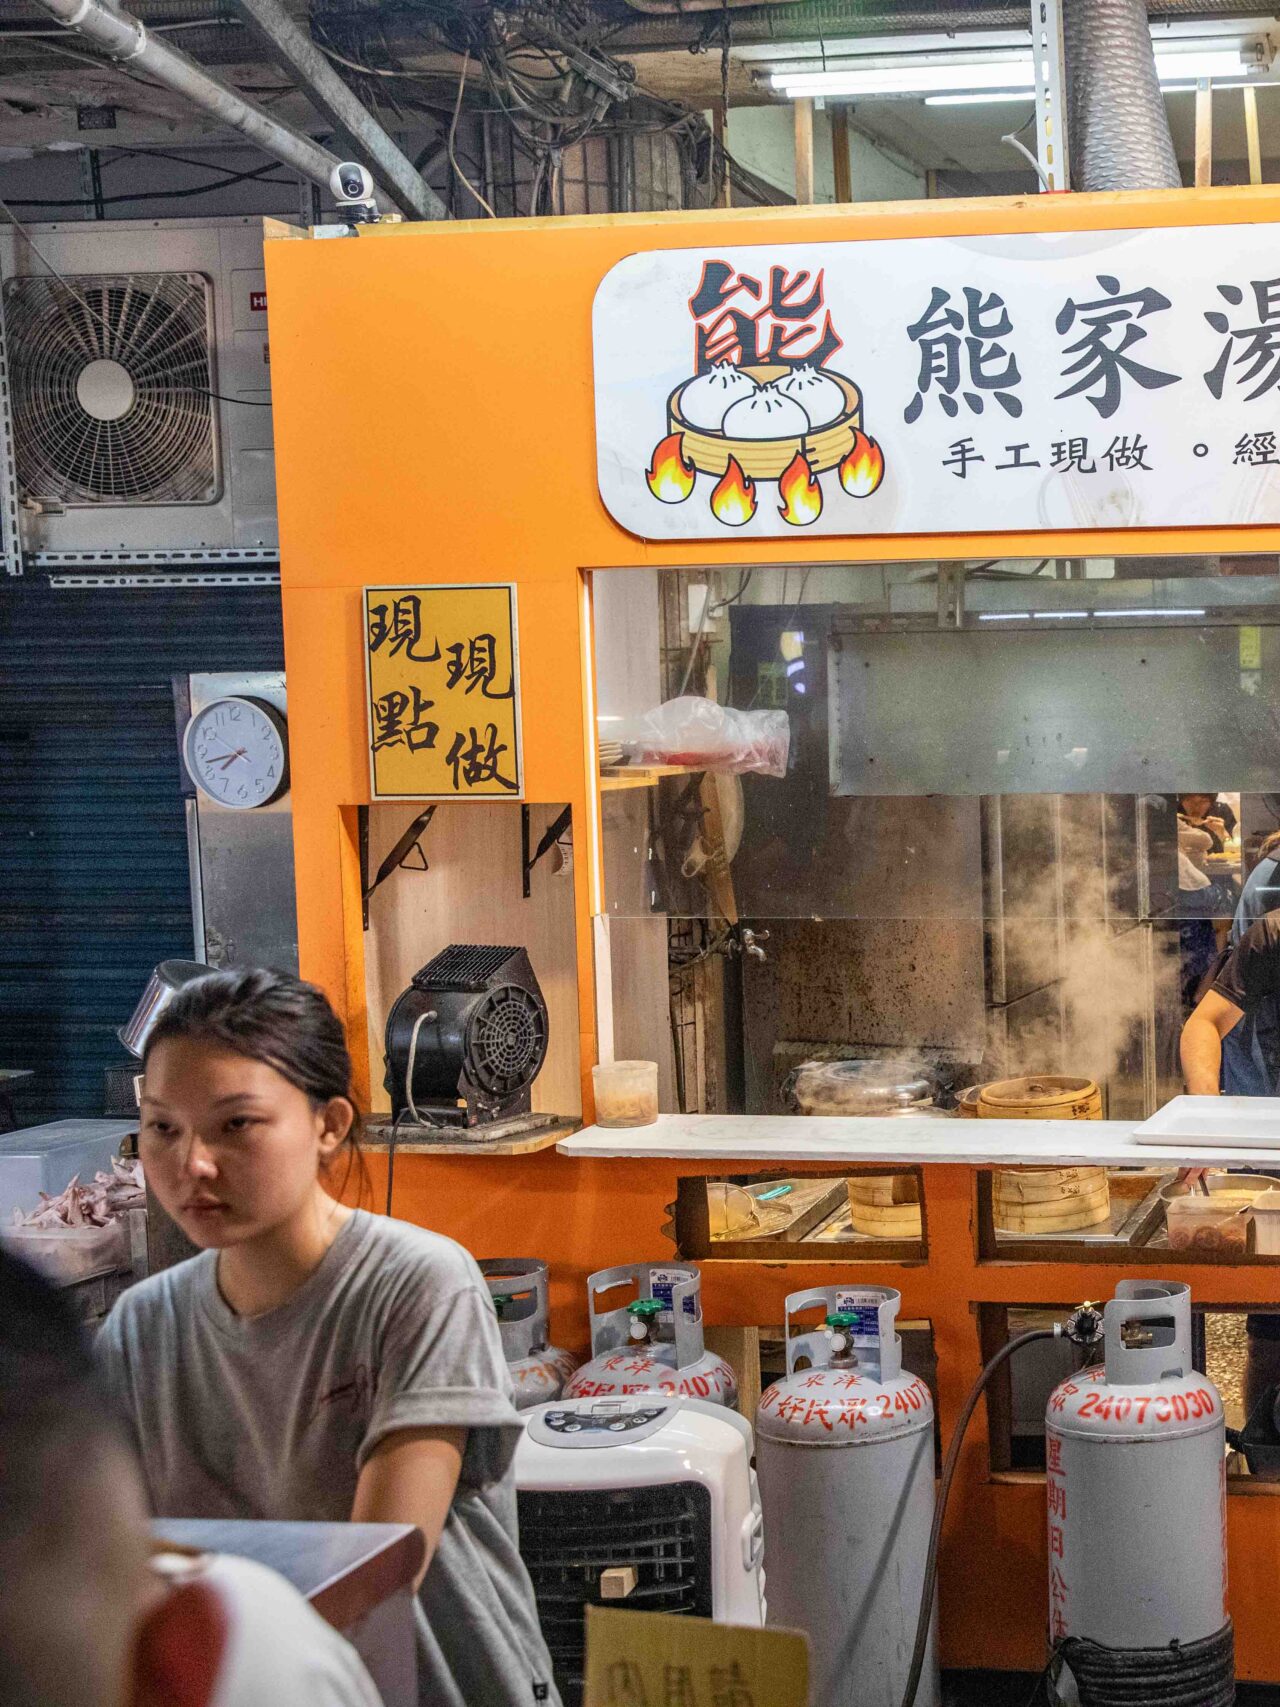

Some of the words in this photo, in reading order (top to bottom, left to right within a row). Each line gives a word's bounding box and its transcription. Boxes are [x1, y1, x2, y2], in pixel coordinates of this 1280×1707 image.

[215, 712, 225, 726] 11
[229, 706, 241, 721] 12
[202, 726, 217, 741] 10
[261, 726, 272, 740] 2
[197, 744, 208, 759] 9
[270, 745, 279, 760] 3
[205, 765, 215, 780] 8
[267, 765, 275, 778] 4
[220, 777, 229, 793] 7
[237, 784, 248, 799] 6
[255, 779, 265, 793] 5
[1076, 1388, 1215, 1425] 24073030
